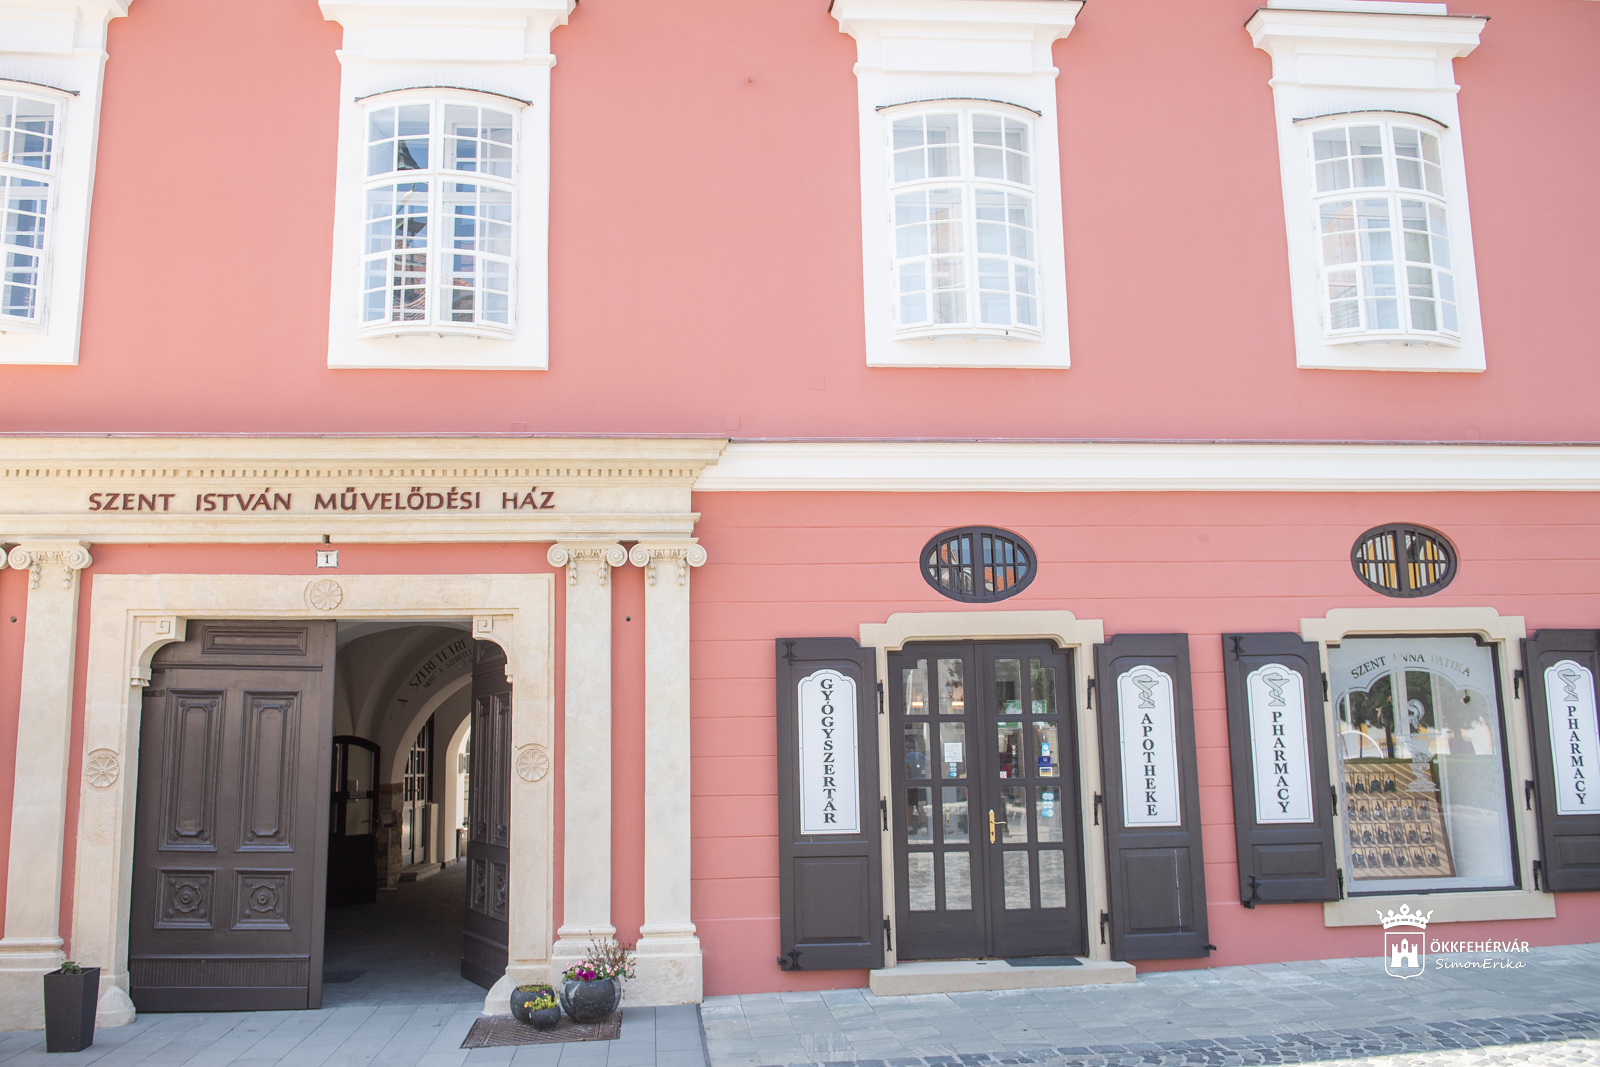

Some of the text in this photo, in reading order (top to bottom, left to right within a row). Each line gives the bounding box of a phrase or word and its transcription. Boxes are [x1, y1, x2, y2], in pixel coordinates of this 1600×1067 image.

[88, 486, 556, 511] SZENT ISTVÁN MŰVELŐDÉSI HÁZ
[1350, 656, 1387, 680] SZENT
[1430, 654, 1471, 677] PATIKA
[820, 678, 837, 824] GYÓGYSZERTÁR
[1140, 713, 1158, 816] APOTHEKE
[1271, 711, 1290, 813] PHARMACY
[1567, 705, 1587, 805] PHARMACY
